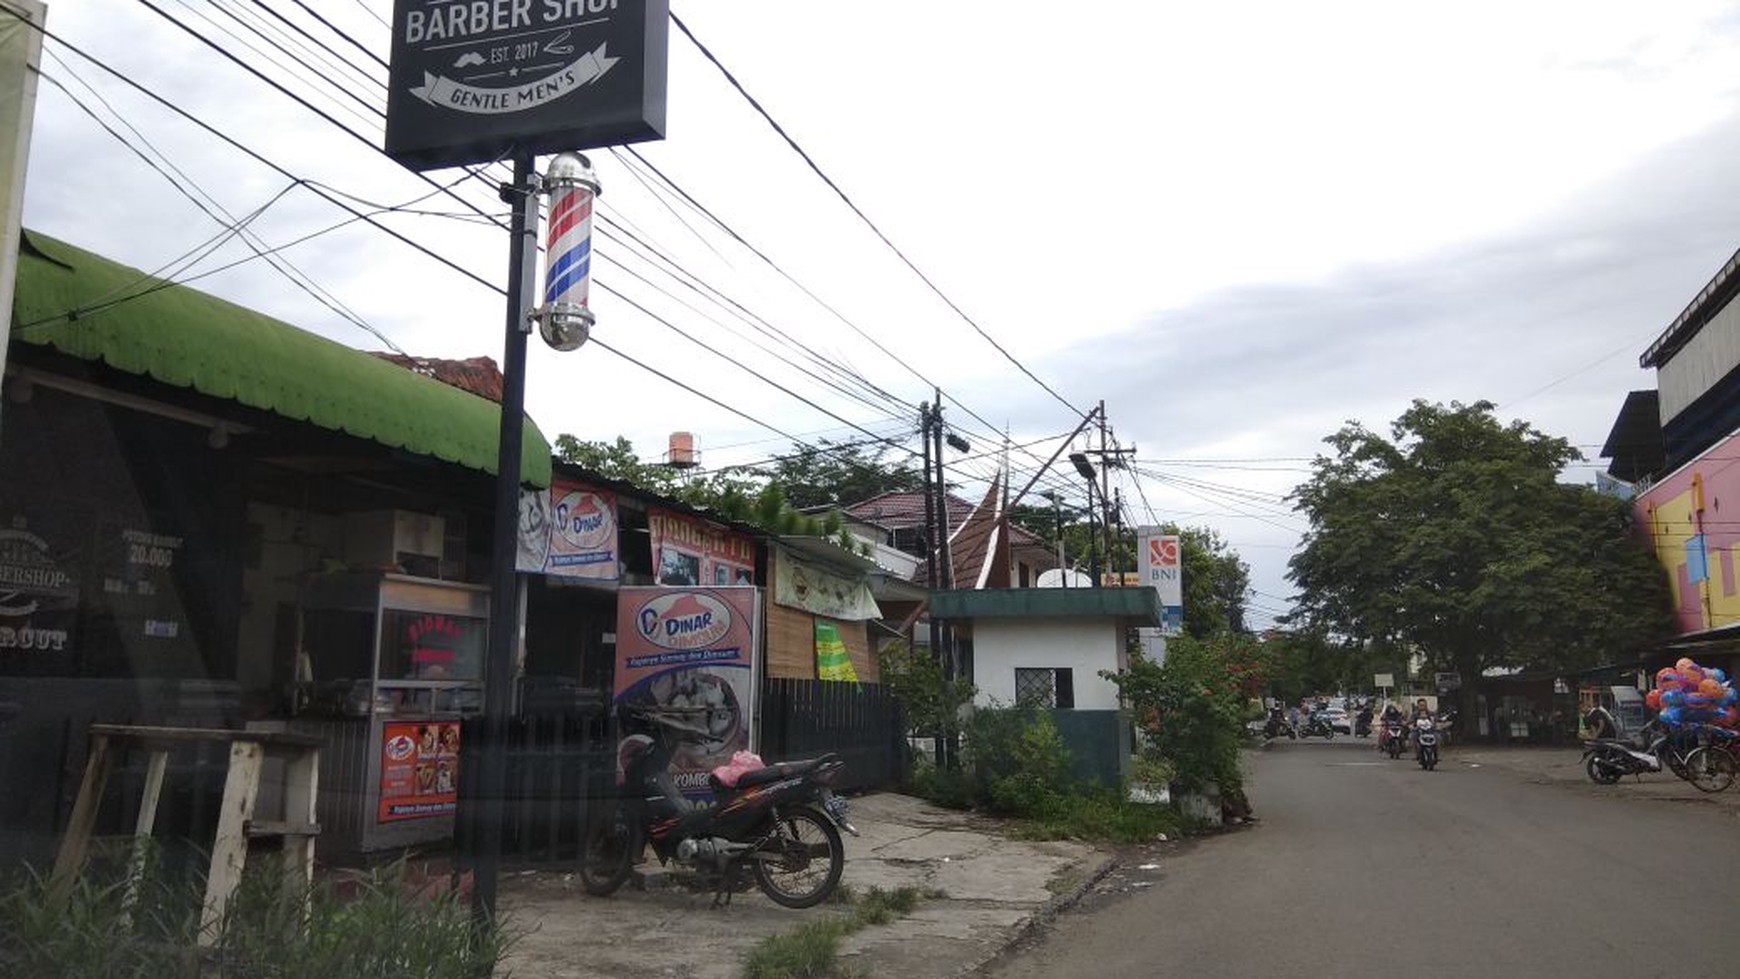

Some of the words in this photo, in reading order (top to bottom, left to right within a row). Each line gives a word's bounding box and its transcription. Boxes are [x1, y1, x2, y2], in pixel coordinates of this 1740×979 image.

[405, 0, 532, 44] BARBER
[515, 42, 539, 61] 2017
[451, 88, 510, 110] GENTLE
[517, 70, 576, 103] MEN'S
[0, 565, 66, 588] ERSHOP
[1152, 568, 1177, 580] BNI
[665, 612, 713, 636] DINAR
